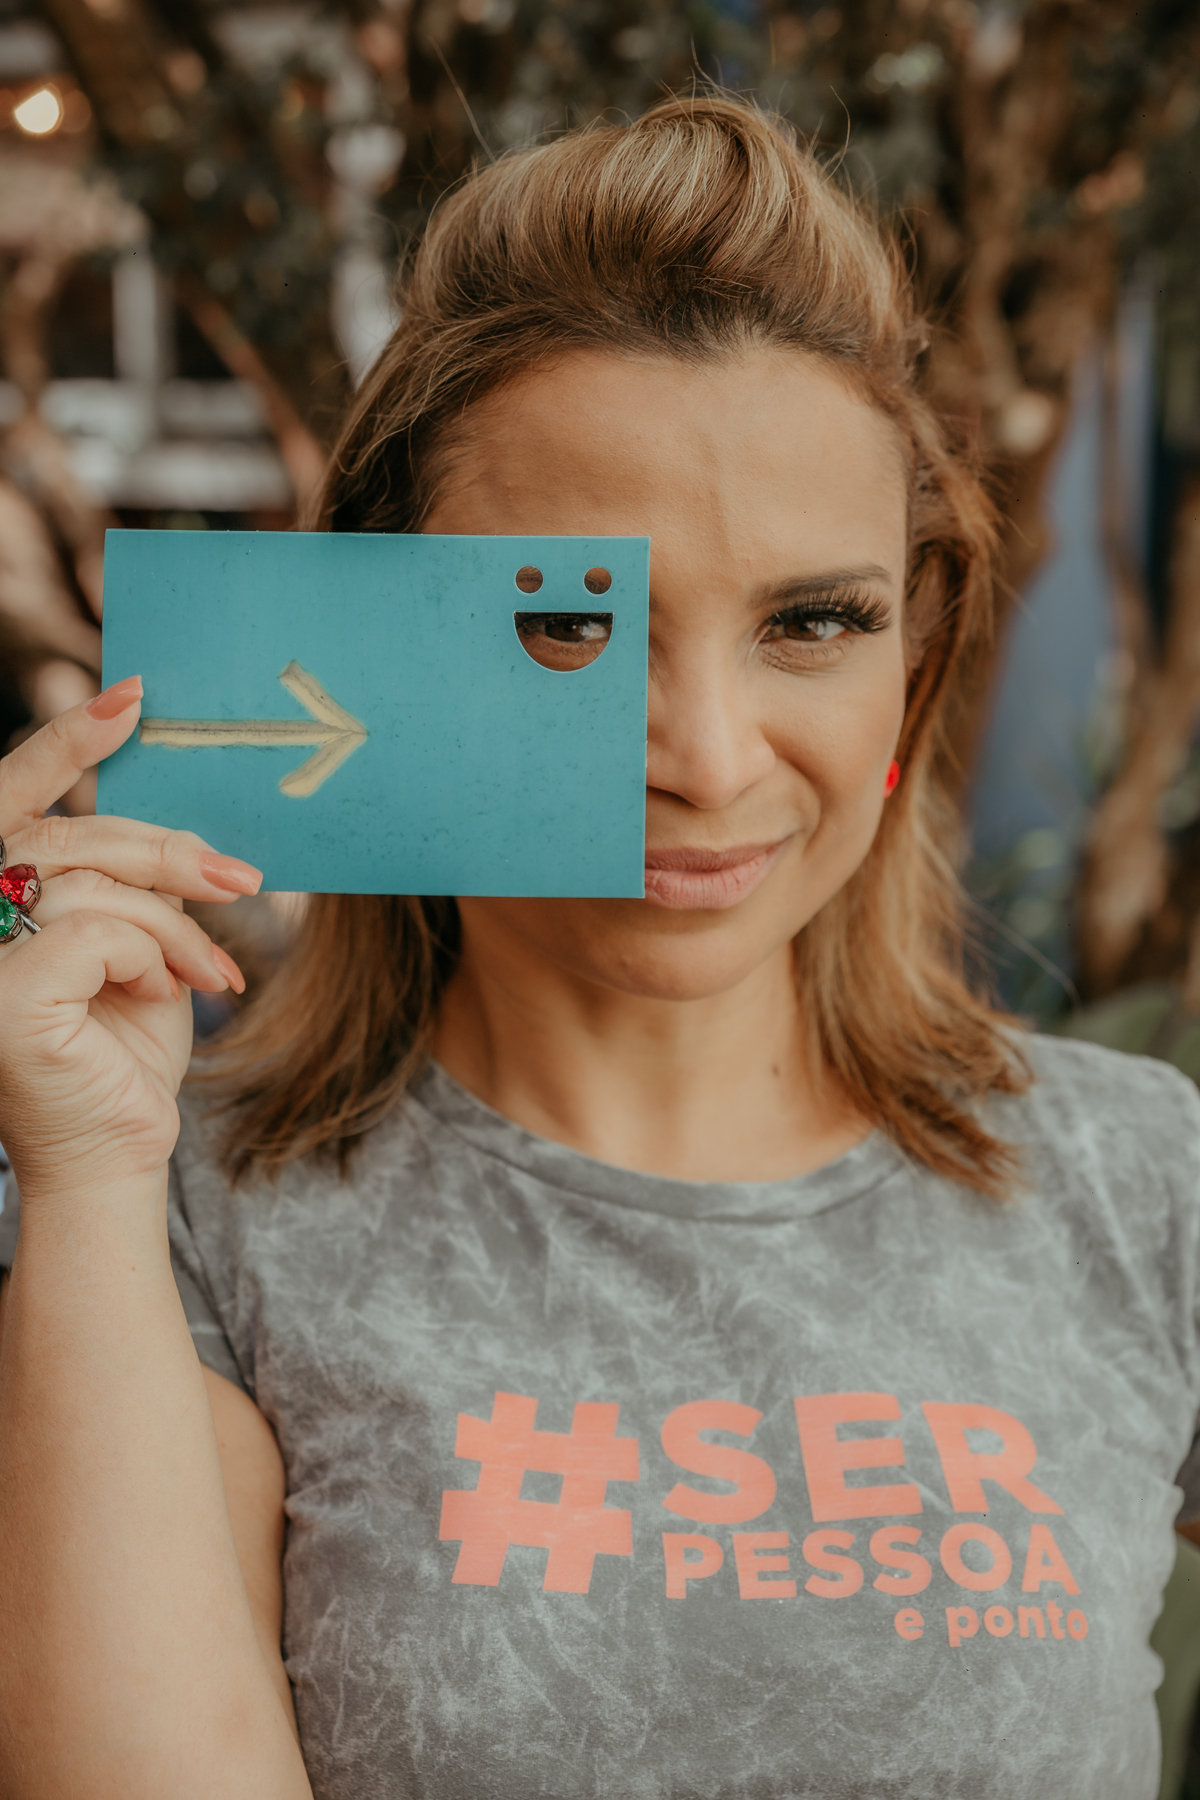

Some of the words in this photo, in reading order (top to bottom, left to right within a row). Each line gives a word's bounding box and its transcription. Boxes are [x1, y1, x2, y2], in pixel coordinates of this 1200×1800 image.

[439, 1392, 1065, 1596] #SER
[662, 1522, 1081, 1600] PESSOA
[894, 1608, 924, 1641] e
[945, 1600, 1088, 1648] ponto
